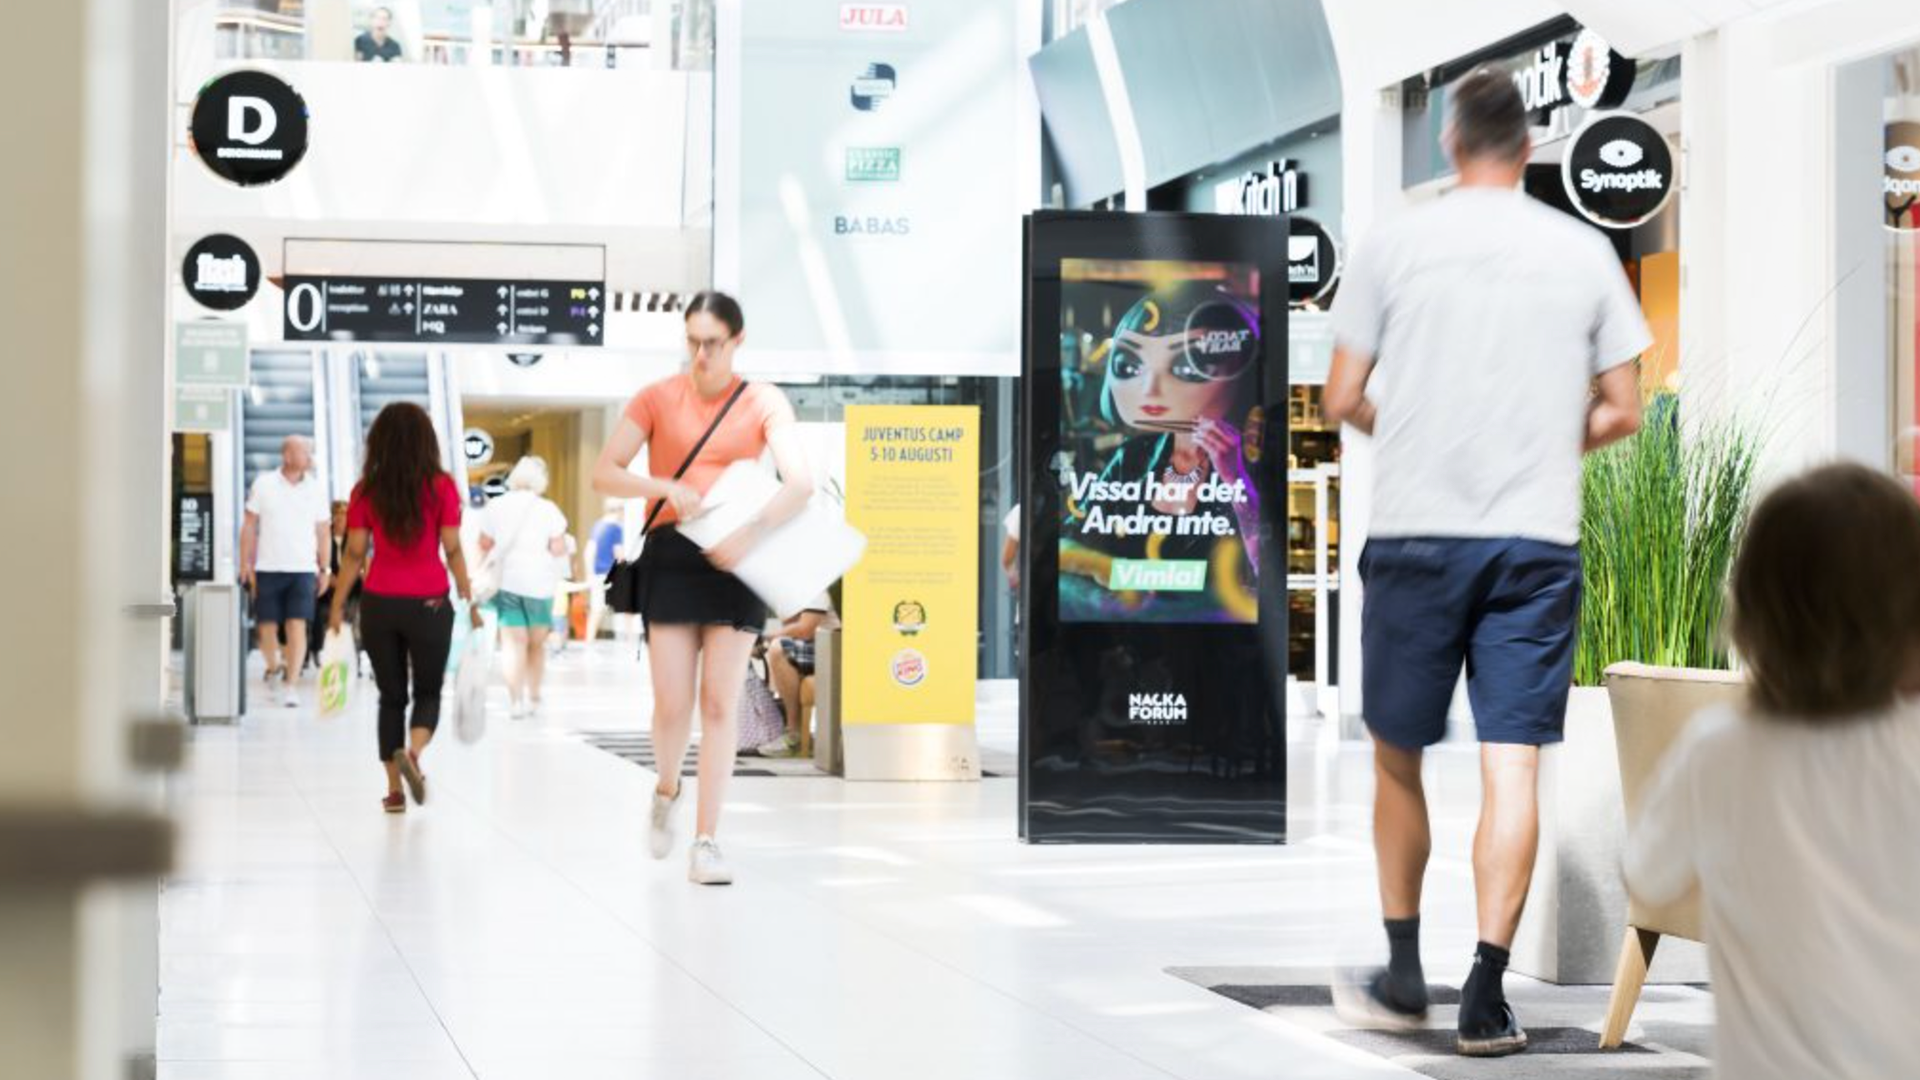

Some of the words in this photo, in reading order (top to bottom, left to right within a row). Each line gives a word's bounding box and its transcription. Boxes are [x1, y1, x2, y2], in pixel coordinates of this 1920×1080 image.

[841, 8, 905, 26] JULA
[228, 95, 277, 145] D
[848, 158, 899, 172] PIZZA
[1580, 168, 1663, 193] Synoptik
[834, 216, 910, 234] BABAS
[423, 304, 458, 315] ZARA
[423, 321, 445, 333] MQ
[862, 427, 926, 442] JUVENTUS
[928, 427, 964, 442] CAMP
[899, 447, 953, 462] AUGUSTI
[1069, 472, 1141, 501] Vissa
[1144, 471, 1193, 501] har
[1196, 474, 1249, 502] det.
[1082, 504, 1173, 535] Andra
[1175, 511, 1236, 535] inte.
[1129, 693, 1187, 707] NACKA
[1129, 706, 1187, 720] FORUM
